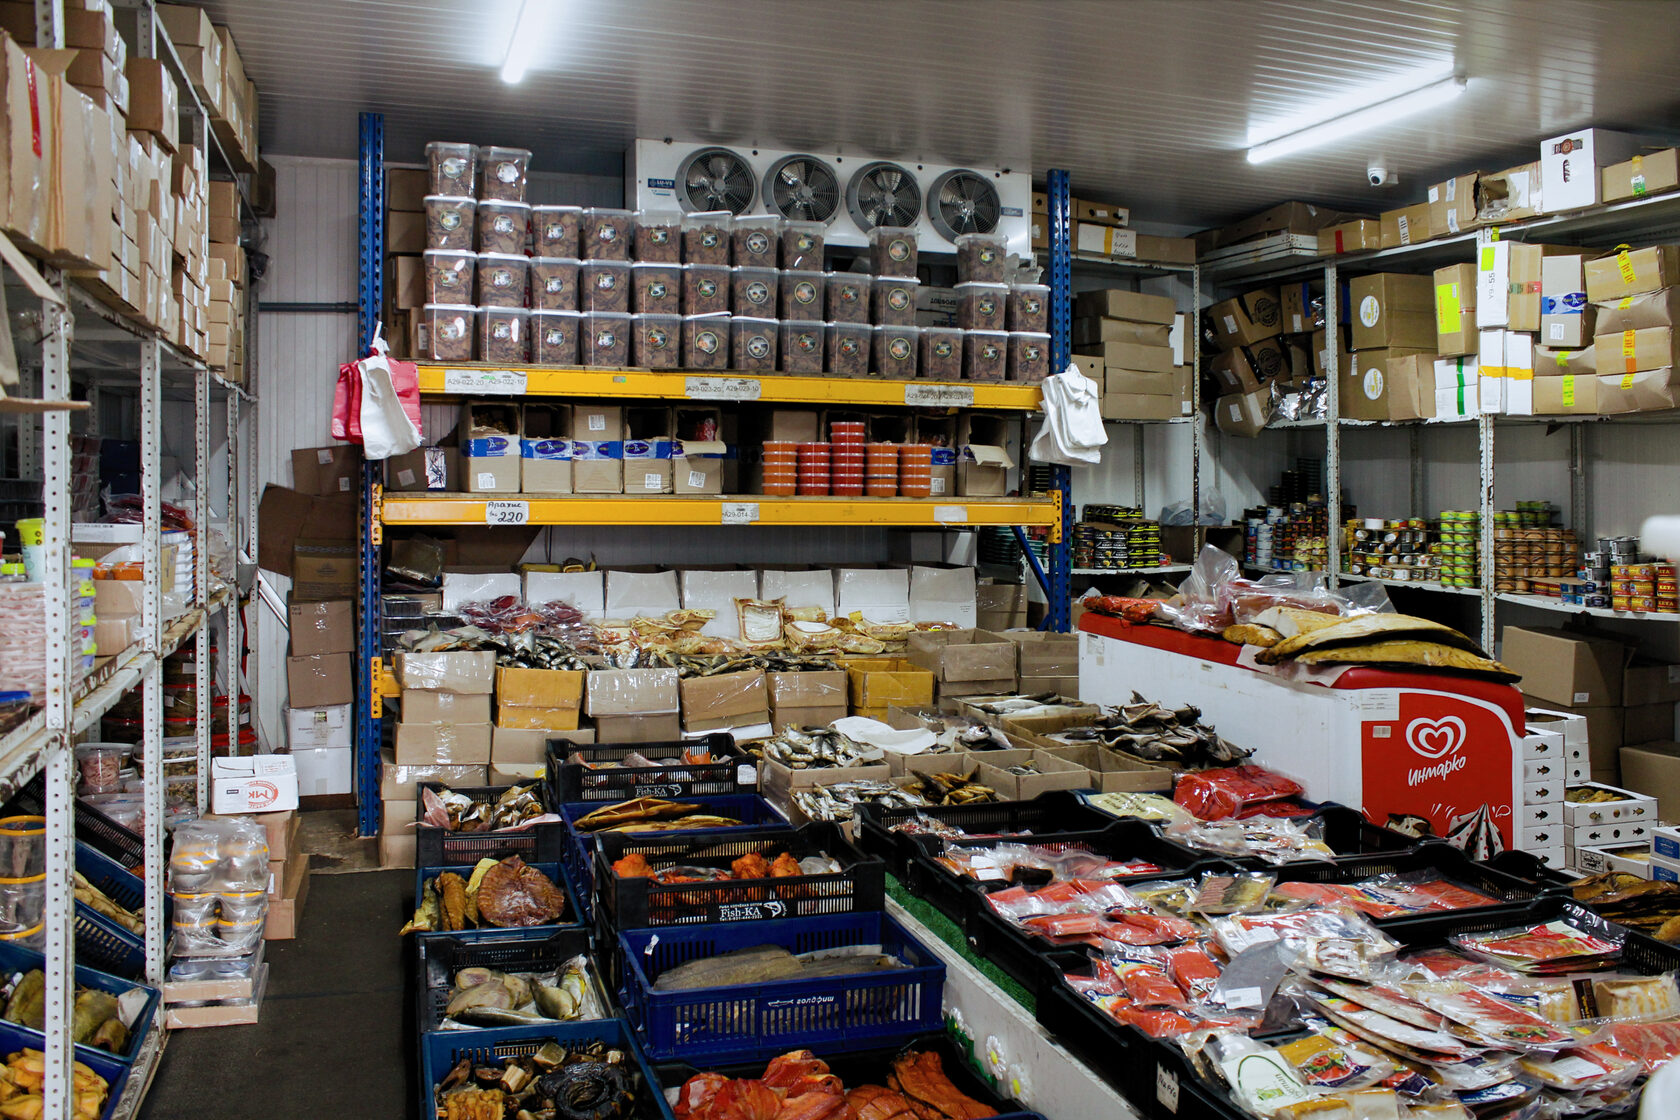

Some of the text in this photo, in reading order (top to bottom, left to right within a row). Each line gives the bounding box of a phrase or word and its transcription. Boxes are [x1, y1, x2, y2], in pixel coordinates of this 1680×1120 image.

[497, 511, 523, 523] 220
[1407, 754, 1467, 787] Инмарко
[636, 787, 667, 796] Fish-KA
[721, 907, 761, 917] Fish-KA
[797, 996, 834, 1004] голдфиш
